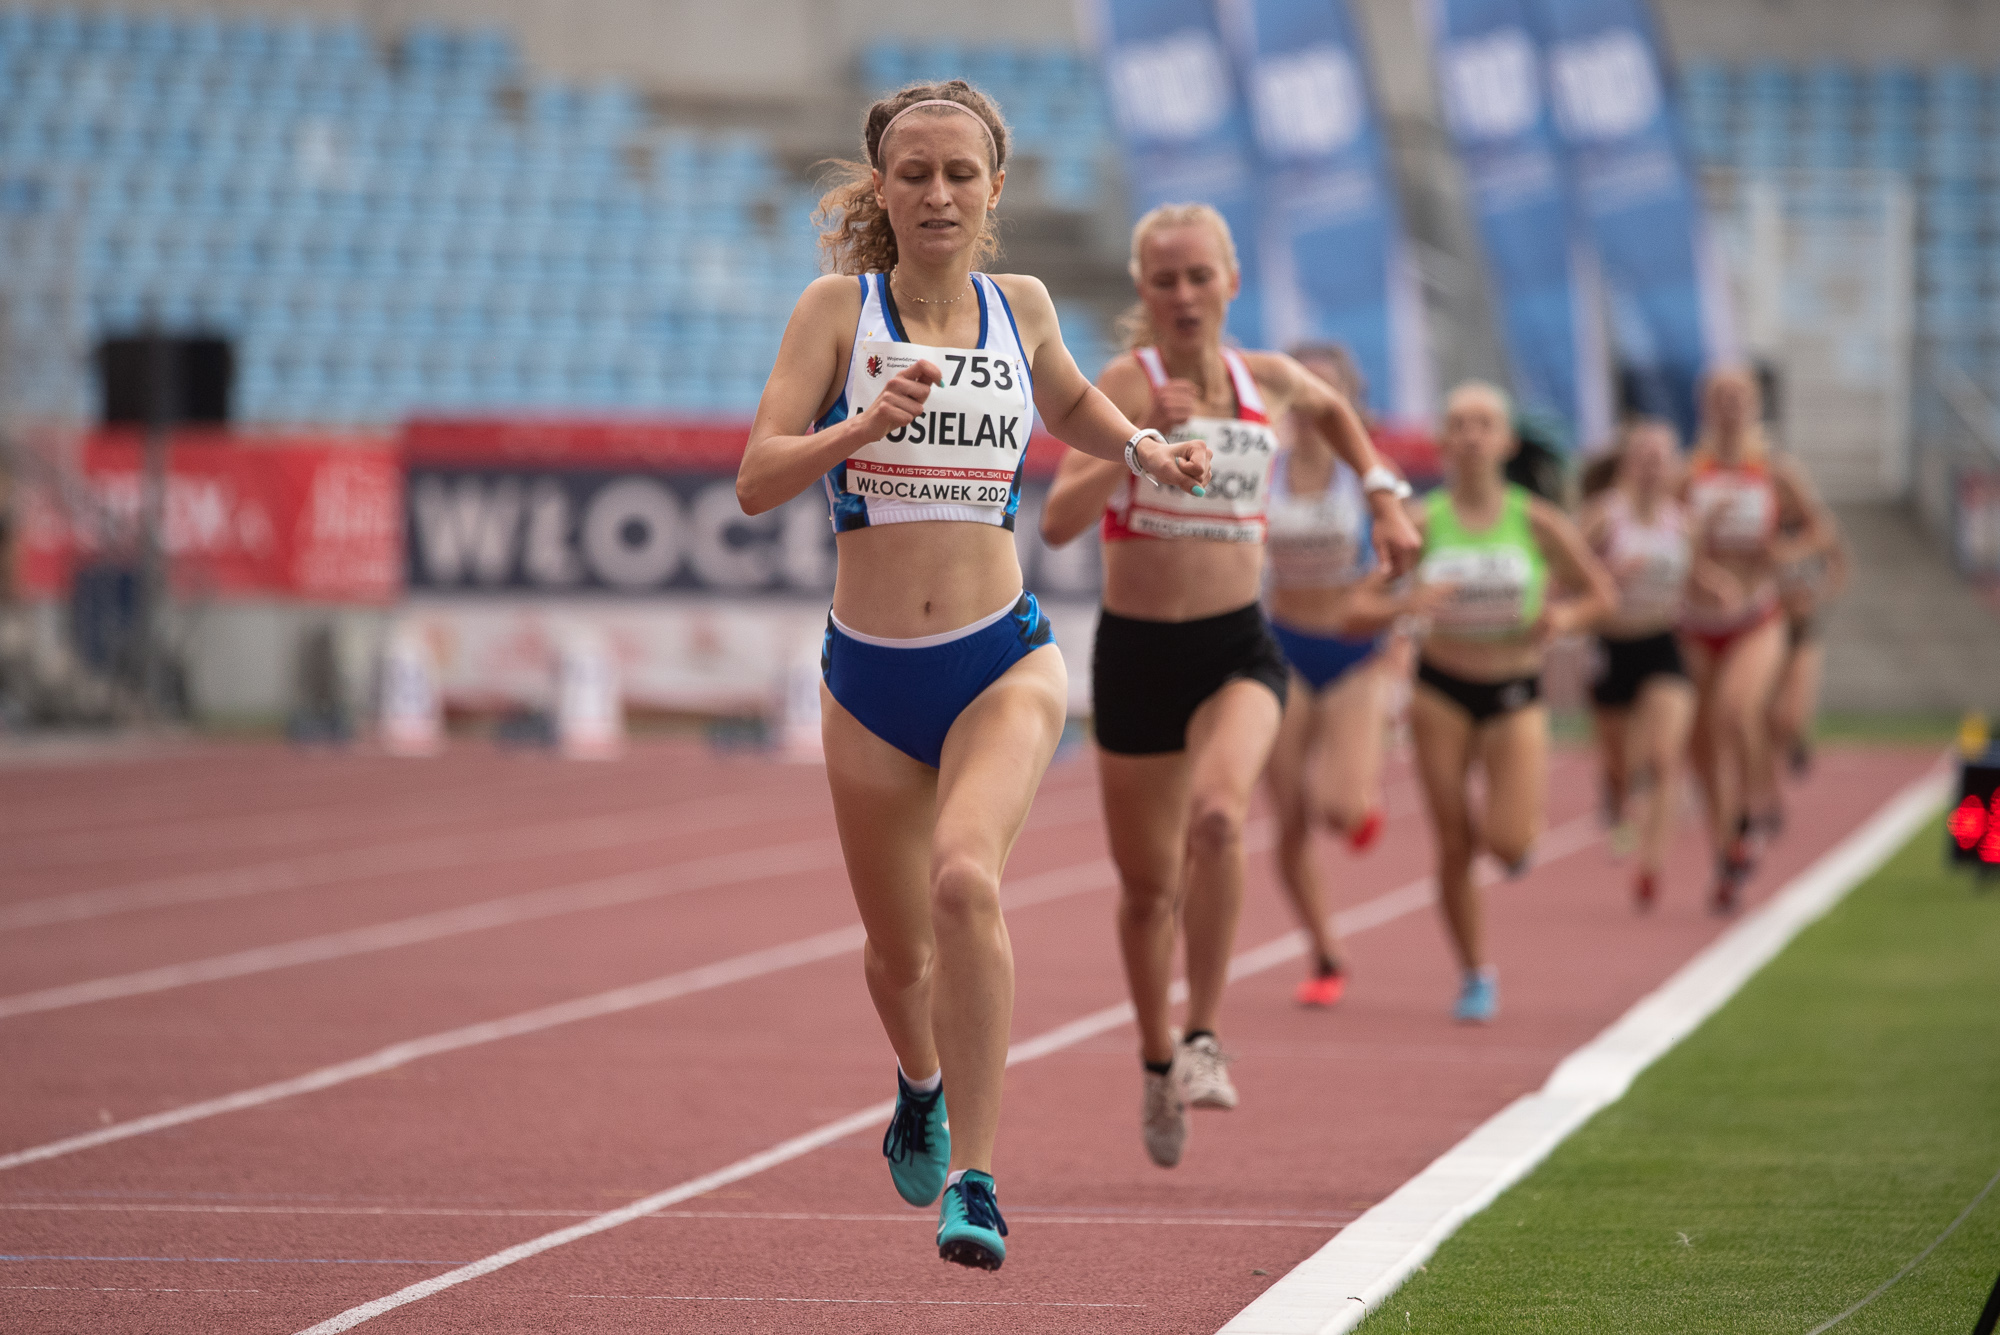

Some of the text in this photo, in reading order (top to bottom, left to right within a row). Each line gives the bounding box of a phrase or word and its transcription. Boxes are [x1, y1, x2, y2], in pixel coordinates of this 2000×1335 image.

[944, 354, 1013, 390] 753
[854, 461, 869, 471] 53.
[870, 465, 894, 474] PZLA
[895, 467, 967, 478] MISTRZOSTWA
[967, 471, 1001, 480] POLSKI
[856, 476, 1008, 503] WŁOCŁAWEK 202
